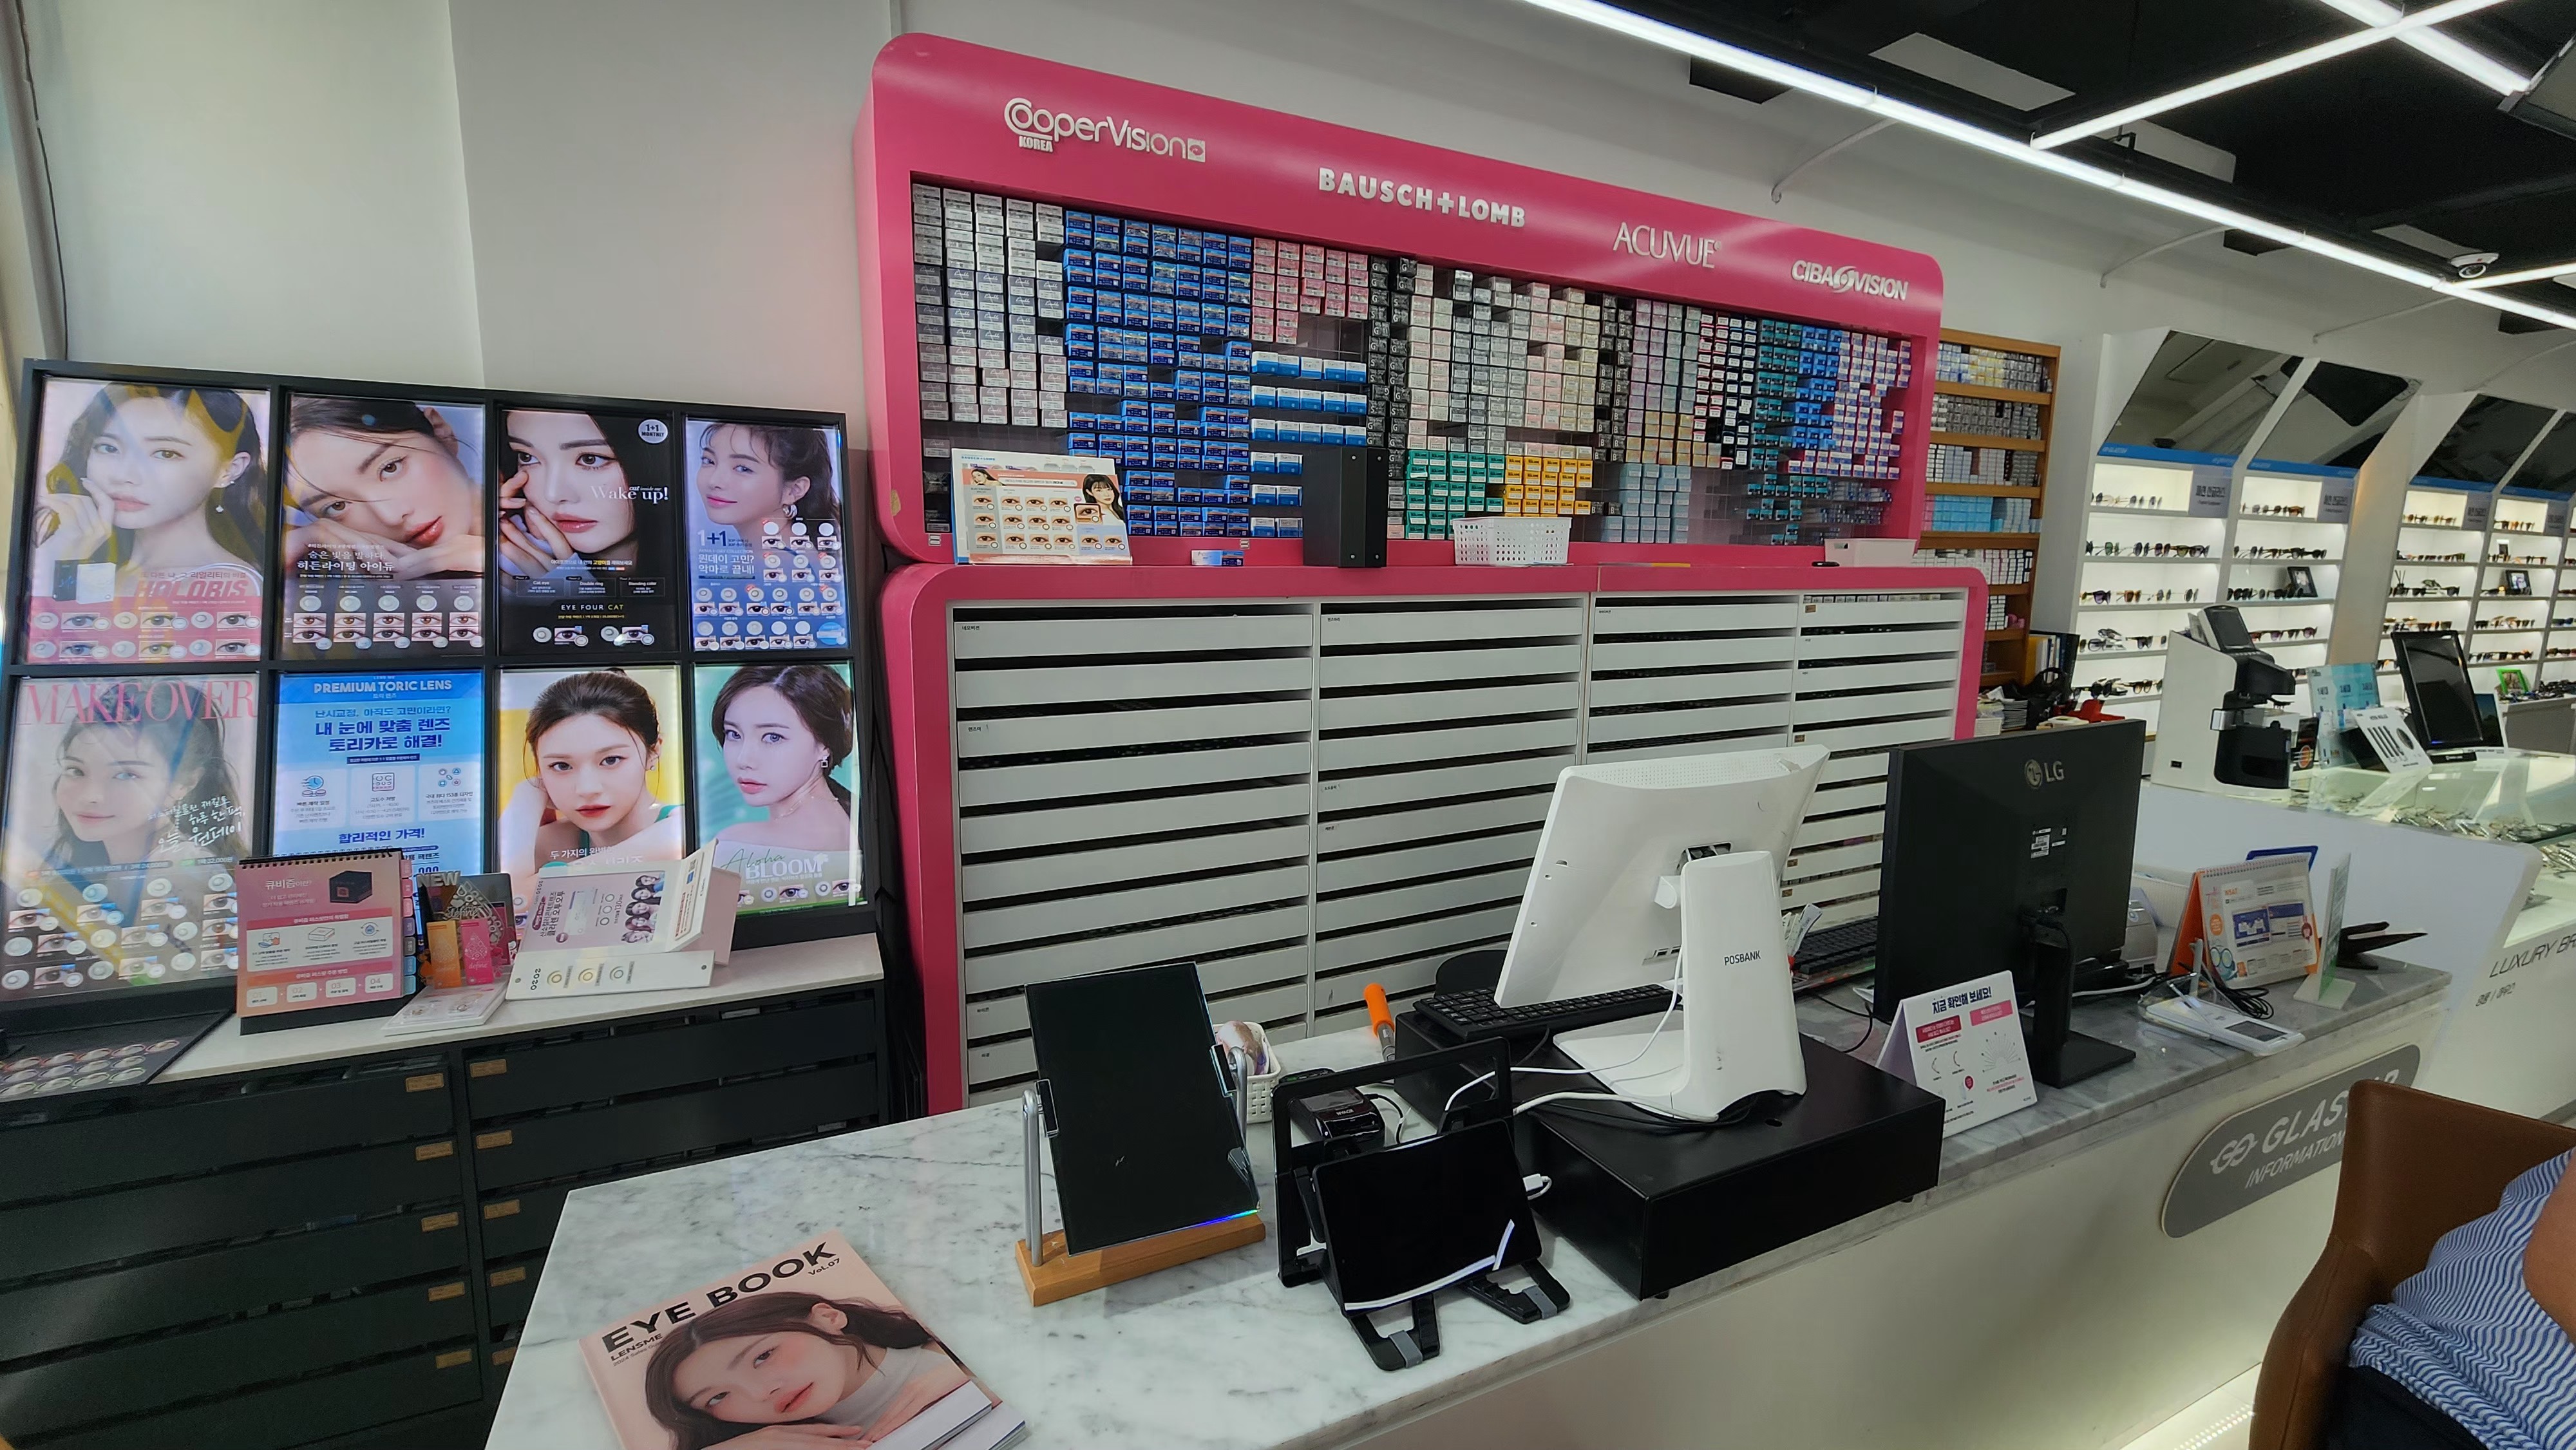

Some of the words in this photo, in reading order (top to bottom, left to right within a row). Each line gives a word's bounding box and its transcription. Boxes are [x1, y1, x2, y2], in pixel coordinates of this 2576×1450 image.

[1004, 97, 1186, 159] CooperVision
[1019, 135, 1054, 152] KOREA
[1613, 221, 1716, 268] ACUVUE
[1858, 272, 1909, 301] VISION
[645, 424, 659, 432] 1+1
[591, 485, 637, 500] Wake
[642, 487, 668, 504] up!
[697, 529, 727, 547] 1+1
[308, 551, 329, 560] 숨은
[332, 551, 352, 560] 빛을
[699, 554, 728, 563] 원데이
[731, 554, 754, 565] 고민?
[297, 560, 355, 571] 히든라이팅
[360, 561, 395, 572] 아이듀
[699, 565, 729, 574] 악마로
[732, 565, 755, 574] 끝내!
[314, 682, 377, 693] PREMIUM
[378, 681, 418, 692] TORIC
[420, 680, 451, 691] LENS
[146, 680, 258, 722] OVER
[315, 709, 359, 718] 난시교정,
[364, 708, 393, 716] 아직도
[397, 706, 451, 715] 고민이라면?
[316, 722, 332, 735] 내
[339, 720, 373, 735] 눈에
[379, 719, 412, 733] 맞춤
[418, 718, 450, 731] 렌즈
[328, 737, 397, 752] 토리카로
[404, 734, 442, 749] 해결!
[2043, 760, 2065, 782] LG
[339, 831, 391, 844] 합리적인
[395, 828, 426, 840] 가격!
[418, 852, 440, 860] 팩렌즈
[550, 850, 560, 860] 두
[560, 848, 587, 859] 가지의
[745, 858, 823, 880] BLOOM
[416, 871, 460, 888] NEW
[1723, 950, 1761, 965] POSBANK
[2489, 939, 2558, 978] LUXURY
[1931, 999, 1947, 1015] 지금
[1947, 992, 1969, 1008] 확인해
[1969, 986, 1992, 1003] 보세요!
[2262, 1089, 2349, 1154] GLAS
[2244, 1129, 2347, 1189] INFORMATION
[601, 1301, 696, 1353] EYE
[706, 1241, 837, 1309] BOOK
[611, 1333, 663, 1362] LENSME
